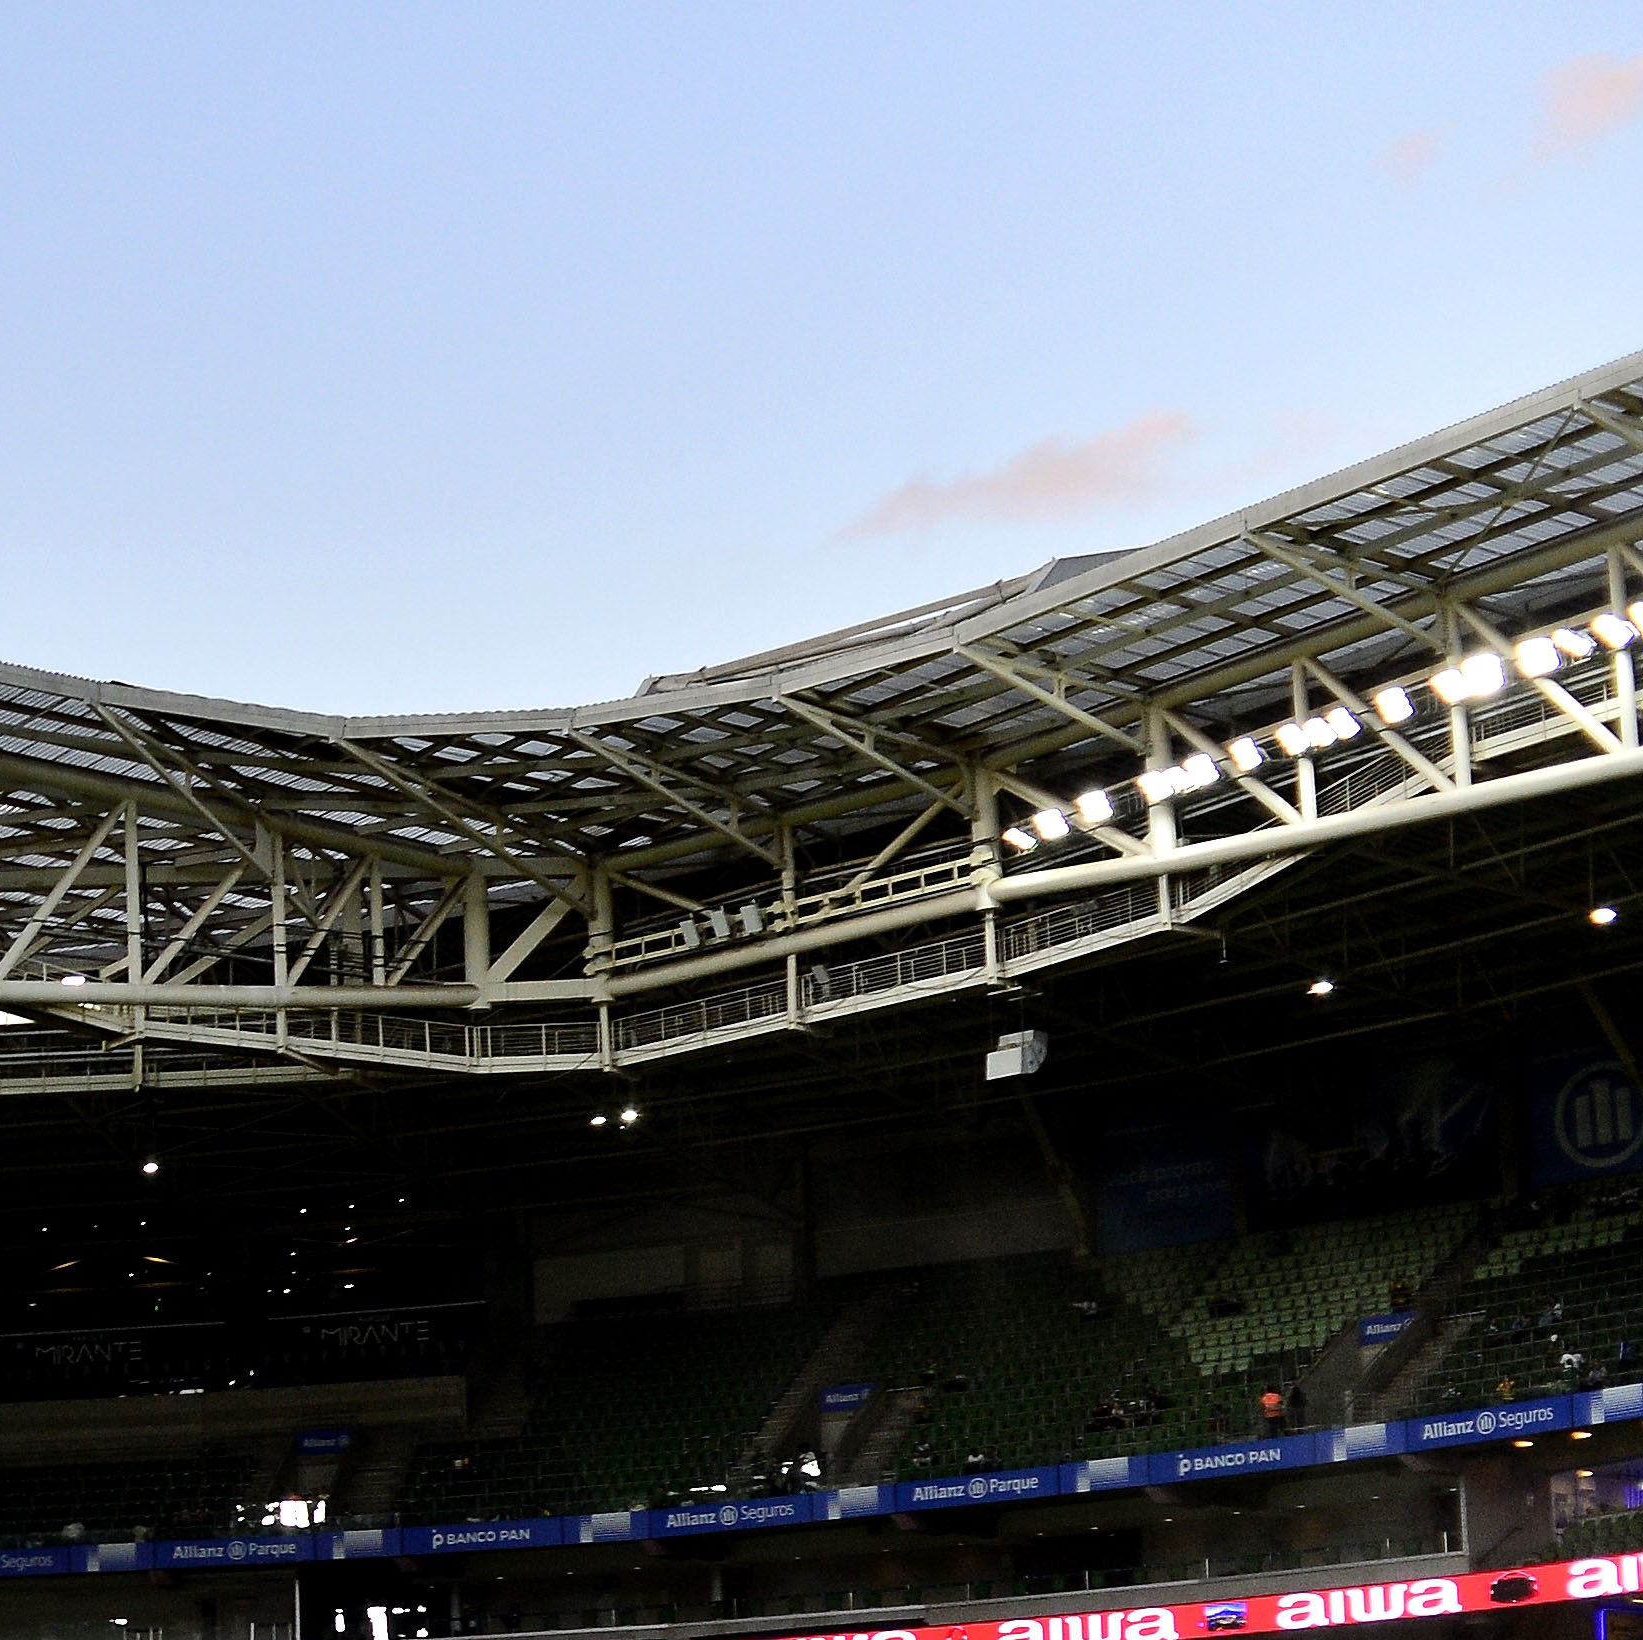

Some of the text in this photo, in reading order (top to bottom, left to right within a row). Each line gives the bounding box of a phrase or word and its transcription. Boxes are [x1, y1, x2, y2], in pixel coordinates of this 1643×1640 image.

[320, 1320, 430, 1346] MIRANTE
[1366, 1322, 1402, 1335] Allianz
[36, 1341, 142, 1366] MIRANTE
[826, 1392, 860, 1404] Allianz
[1422, 1404, 1555, 1441] Allianz Seguros
[1192, 1448, 1282, 1472] BANCO PAN
[912, 1473, 1039, 1502] Allianz Parque
[666, 1503, 795, 1528] Allianz Seguros
[446, 1527, 531, 1546] BANCO PAN
[0, 1551, 54, 1574] Seguros
[172, 1539, 297, 1561] Allianz Parque
[1567, 1556, 1643, 1600] ai
[1276, 1579, 1462, 1630] aiwa
